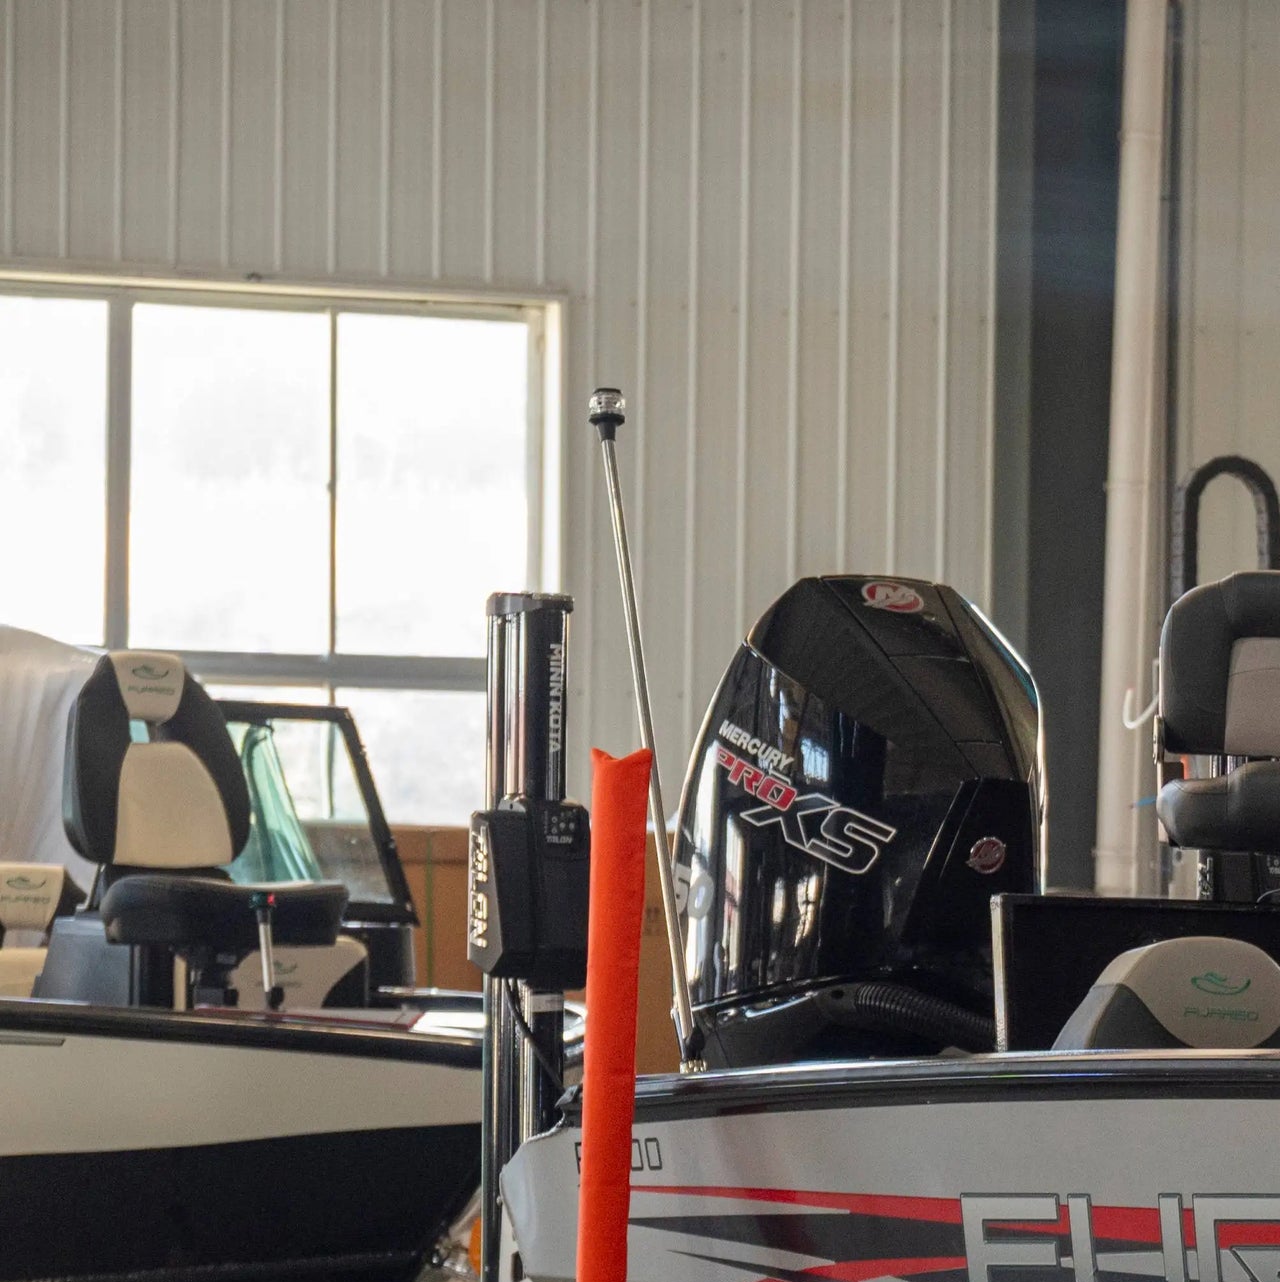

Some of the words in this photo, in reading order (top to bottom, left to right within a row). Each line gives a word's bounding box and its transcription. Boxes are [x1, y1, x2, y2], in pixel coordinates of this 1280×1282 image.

[718, 720, 795, 769] MERCURY
[715, 745, 798, 811] PRO
[546, 836, 573, 844] TALON
[740, 793, 897, 874] XS
[471, 826, 488, 948] TALON
